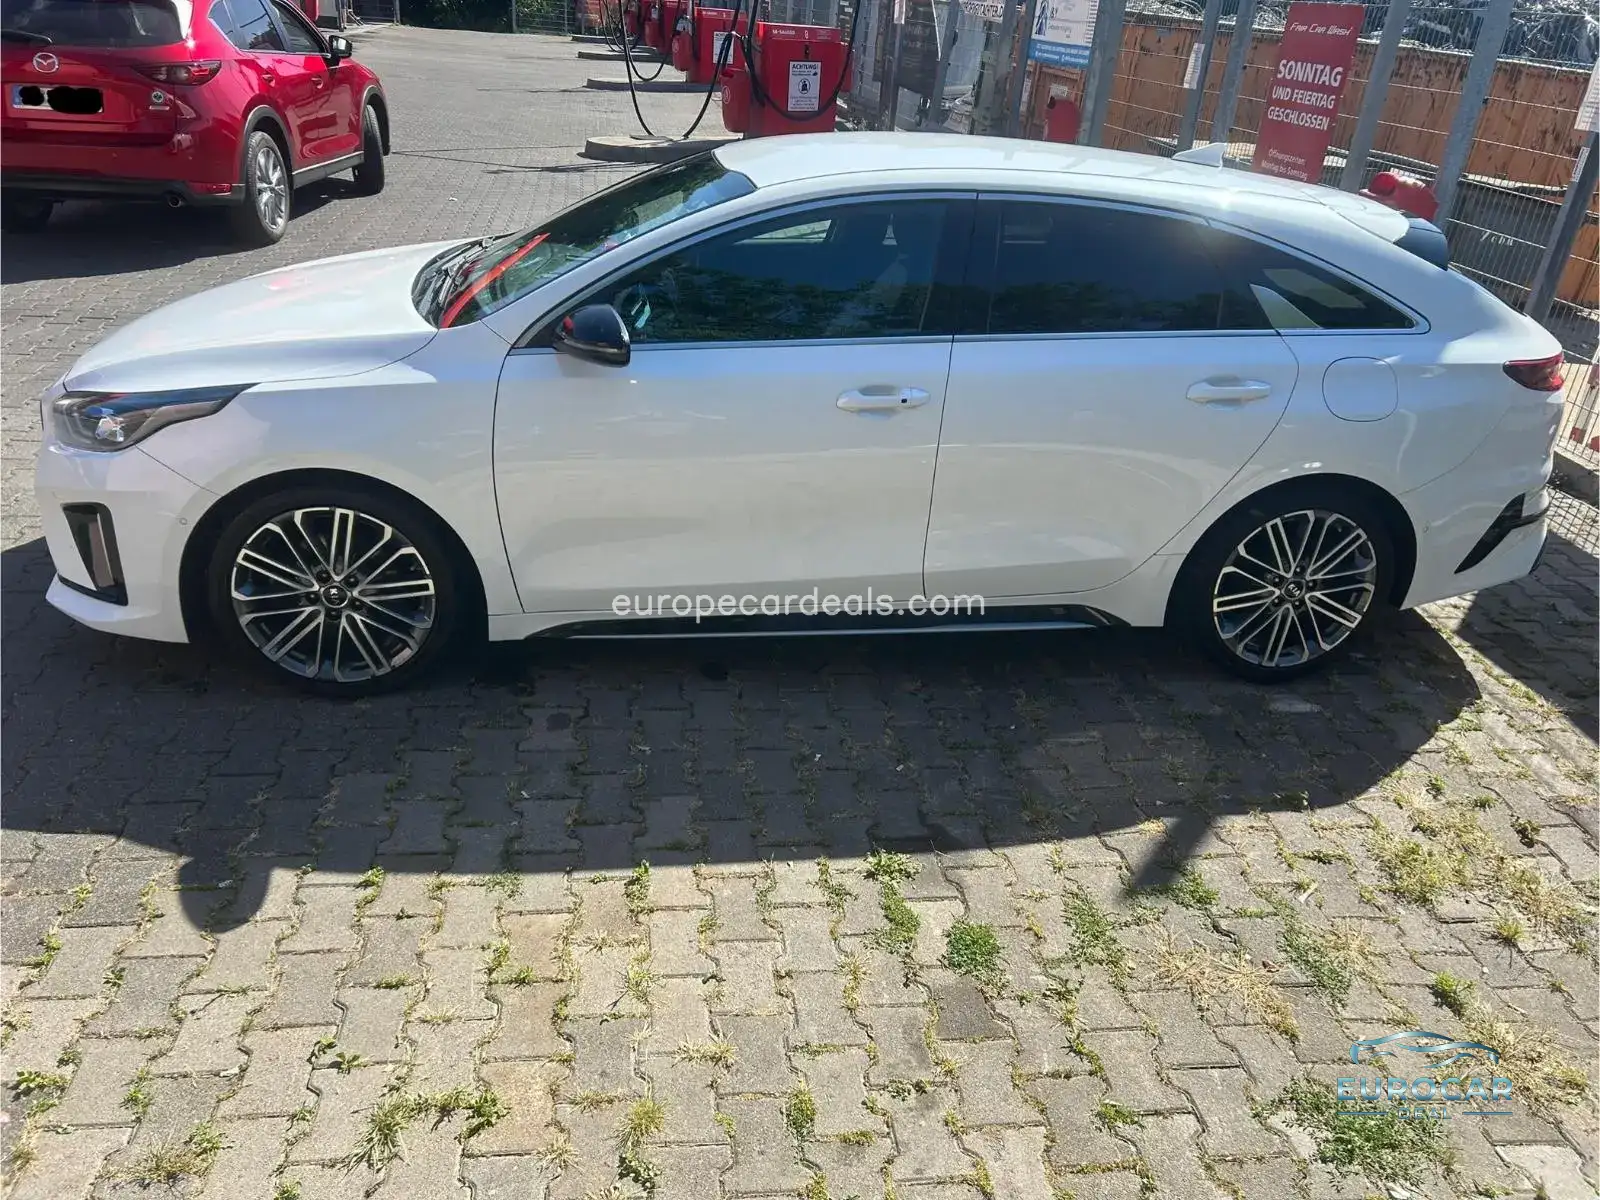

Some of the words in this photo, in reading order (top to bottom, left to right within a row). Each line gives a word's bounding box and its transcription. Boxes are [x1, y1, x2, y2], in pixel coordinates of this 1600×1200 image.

[1277, 59, 1343, 87] SONNTAG
[1272, 85, 1291, 101] UND
[1291, 88, 1335, 109] FEIERTAG
[1267, 105, 1330, 130] GESCHLOSSEN
